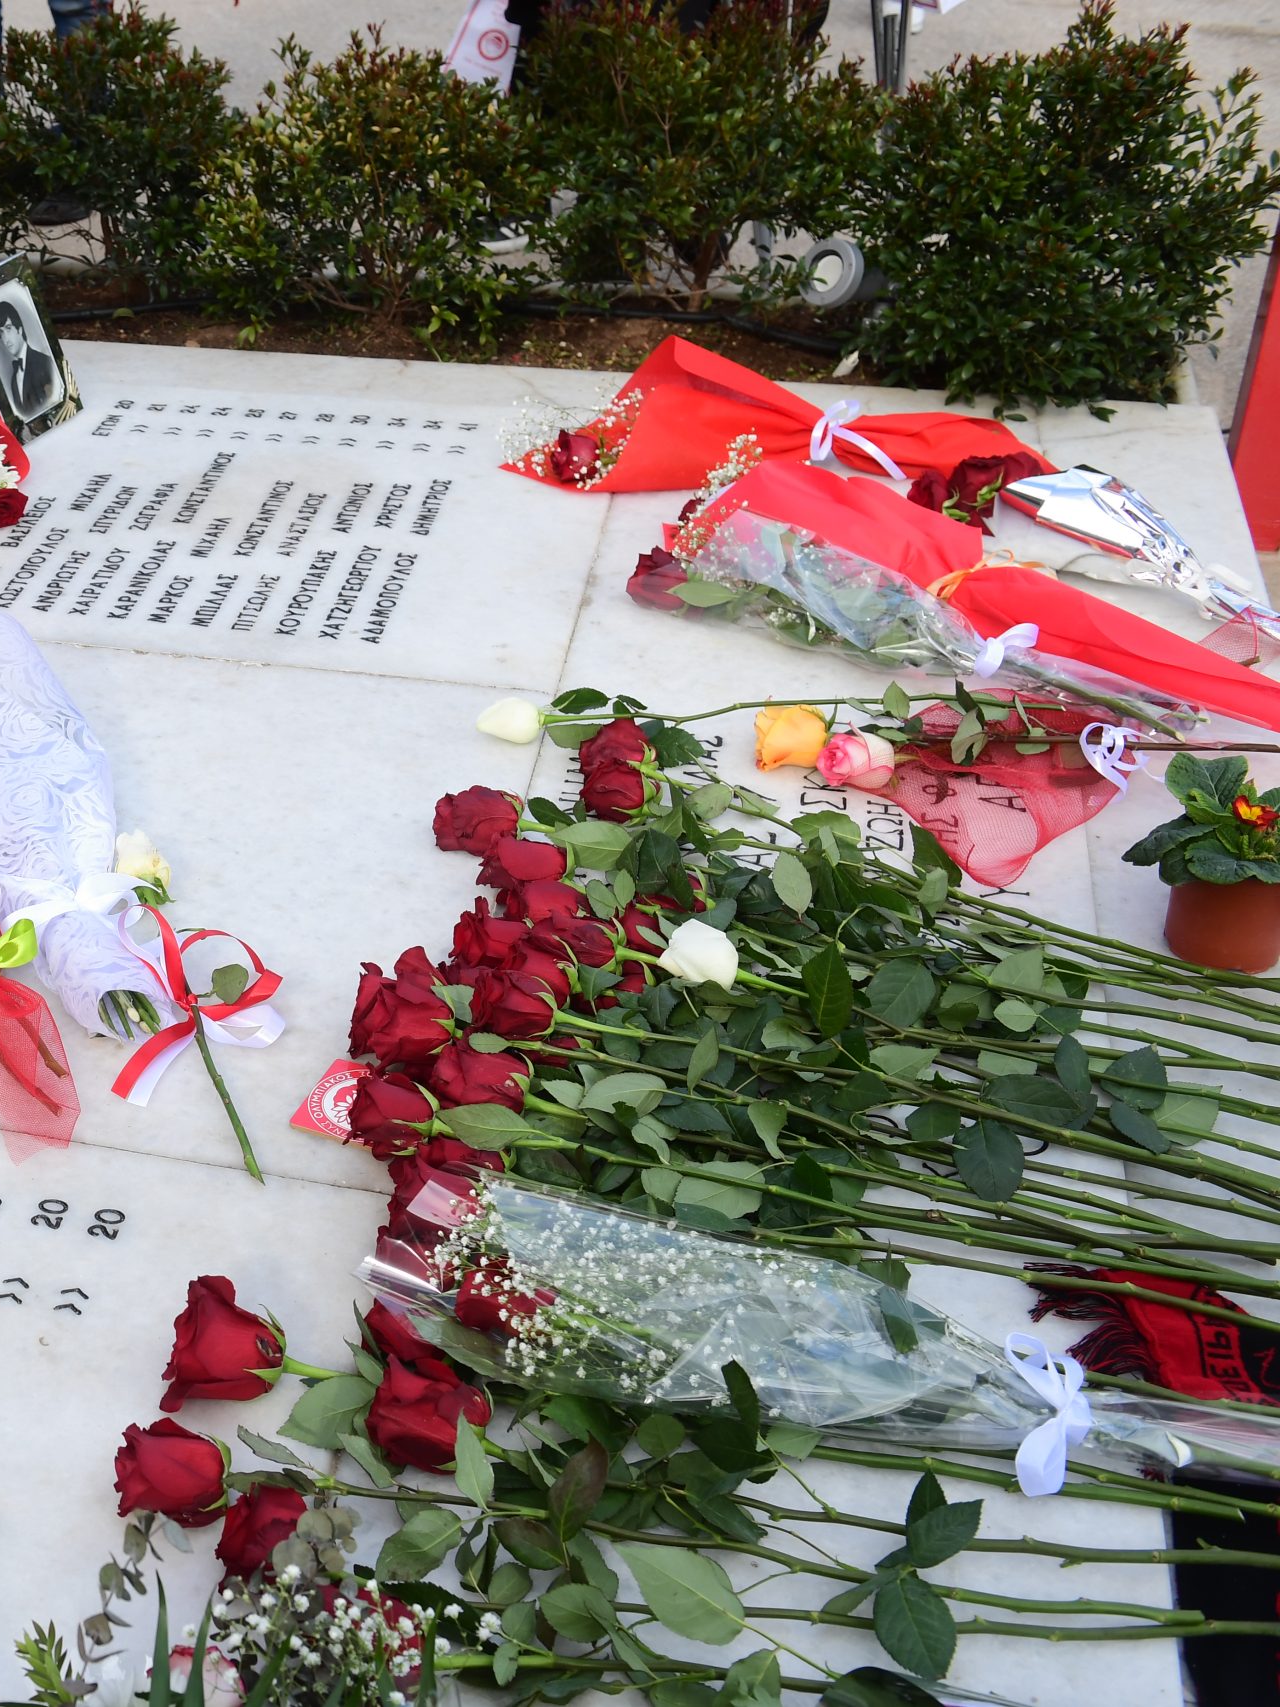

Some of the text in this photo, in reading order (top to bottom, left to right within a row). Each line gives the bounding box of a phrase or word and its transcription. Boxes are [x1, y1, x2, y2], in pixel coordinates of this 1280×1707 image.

[0, 496, 57, 548] ΒΑΣΙΛΕΙΟΣ
[91, 414, 123, 437] ΕΤΩΝ
[67, 473, 113, 512] ΜΙΧΑΗΛ
[106, 539, 177, 620] ΚΑΡΑΝΙΚΟΛΑΣ
[171, 451, 237, 525] ΚΩΝΣΤΑΝΤΙΝΟΣ
[232, 479, 295, 557] ΚΩΝΣΤΑΝΤΙΝΟΣ
[31, 550, 91, 613] ΑΝΔΡΙΩΤΗΣ
[88, 485, 139, 535] ΣΠΥΡΙΔΩΝ
[67, 547, 131, 616] ΧΑΙΡΑΤΙΔΟΥ
[127, 482, 180, 532] ΖΩΓΡΑΦΙΑ
[146, 574, 195, 624] ΜΑΡΚΟΣ
[189, 517, 232, 559] ΜΙΧΑΗΛ
[230, 573, 281, 632] ΠΙΤΣΩΛΗΣ
[276, 492, 328, 557] ΑΝΑΣΤΑΣΙΟΣ
[273, 549, 338, 636] ΚΟΥΡΟΥΠΑΚΗΣ
[330, 482, 374, 534] ΑΝΤΩΝΙΟΣ
[317, 544, 383, 640] ΧΑΤΖΗΓΕΩΡΓΙΟΥ
[373, 483, 413, 529] ΧΡΗΣΤΟΣ
[359, 552, 419, 645] ΑΔΑΜΟΠΟΥΛΟΣ
[409, 478, 453, 537] ΔΗΜΗΤΡΙΟΣ
[310, 1072, 353, 1119] ΟΛΥΜΠΙΑΚΟΣ
[31, 1199, 68, 1230] 20
[87, 1209, 125, 1240] 20
